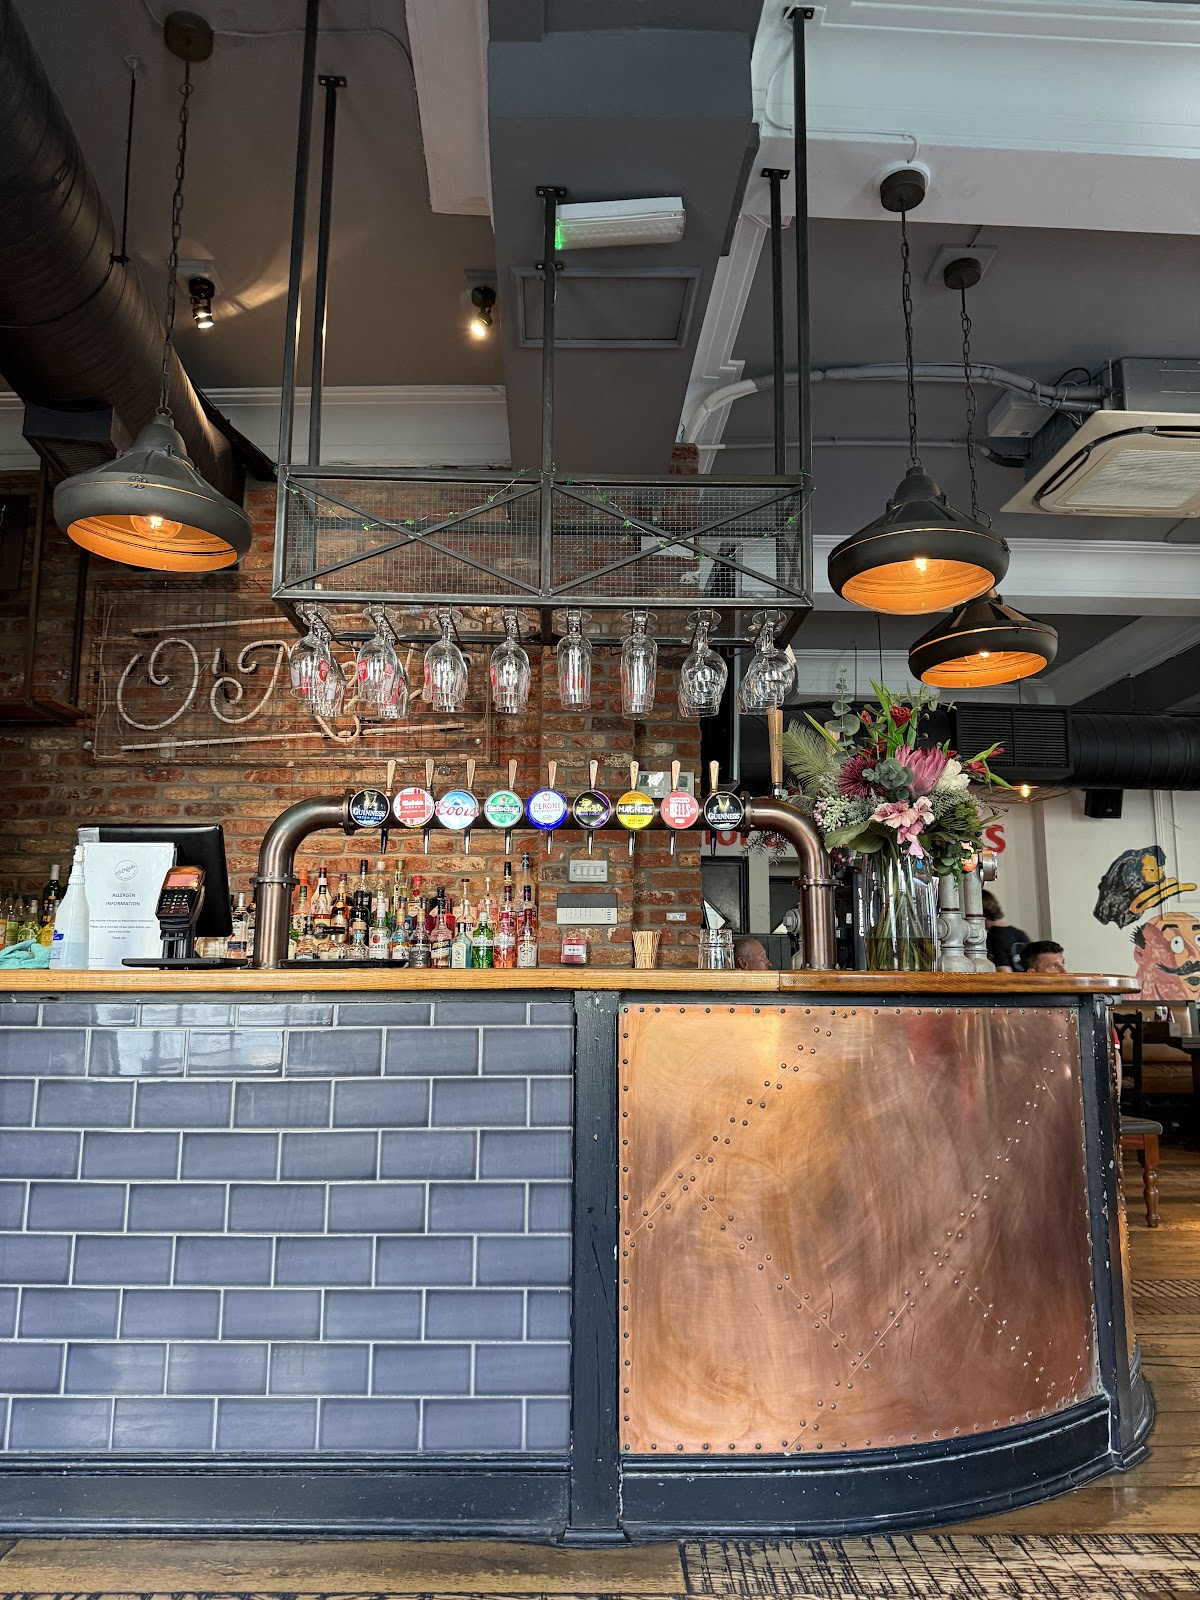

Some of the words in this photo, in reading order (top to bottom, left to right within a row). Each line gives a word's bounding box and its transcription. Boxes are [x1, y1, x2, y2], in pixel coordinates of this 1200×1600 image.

[352, 807, 386, 816] GUINNESS
[435, 801, 479, 817] Coors
[618, 805, 653, 813] MAGNERS
